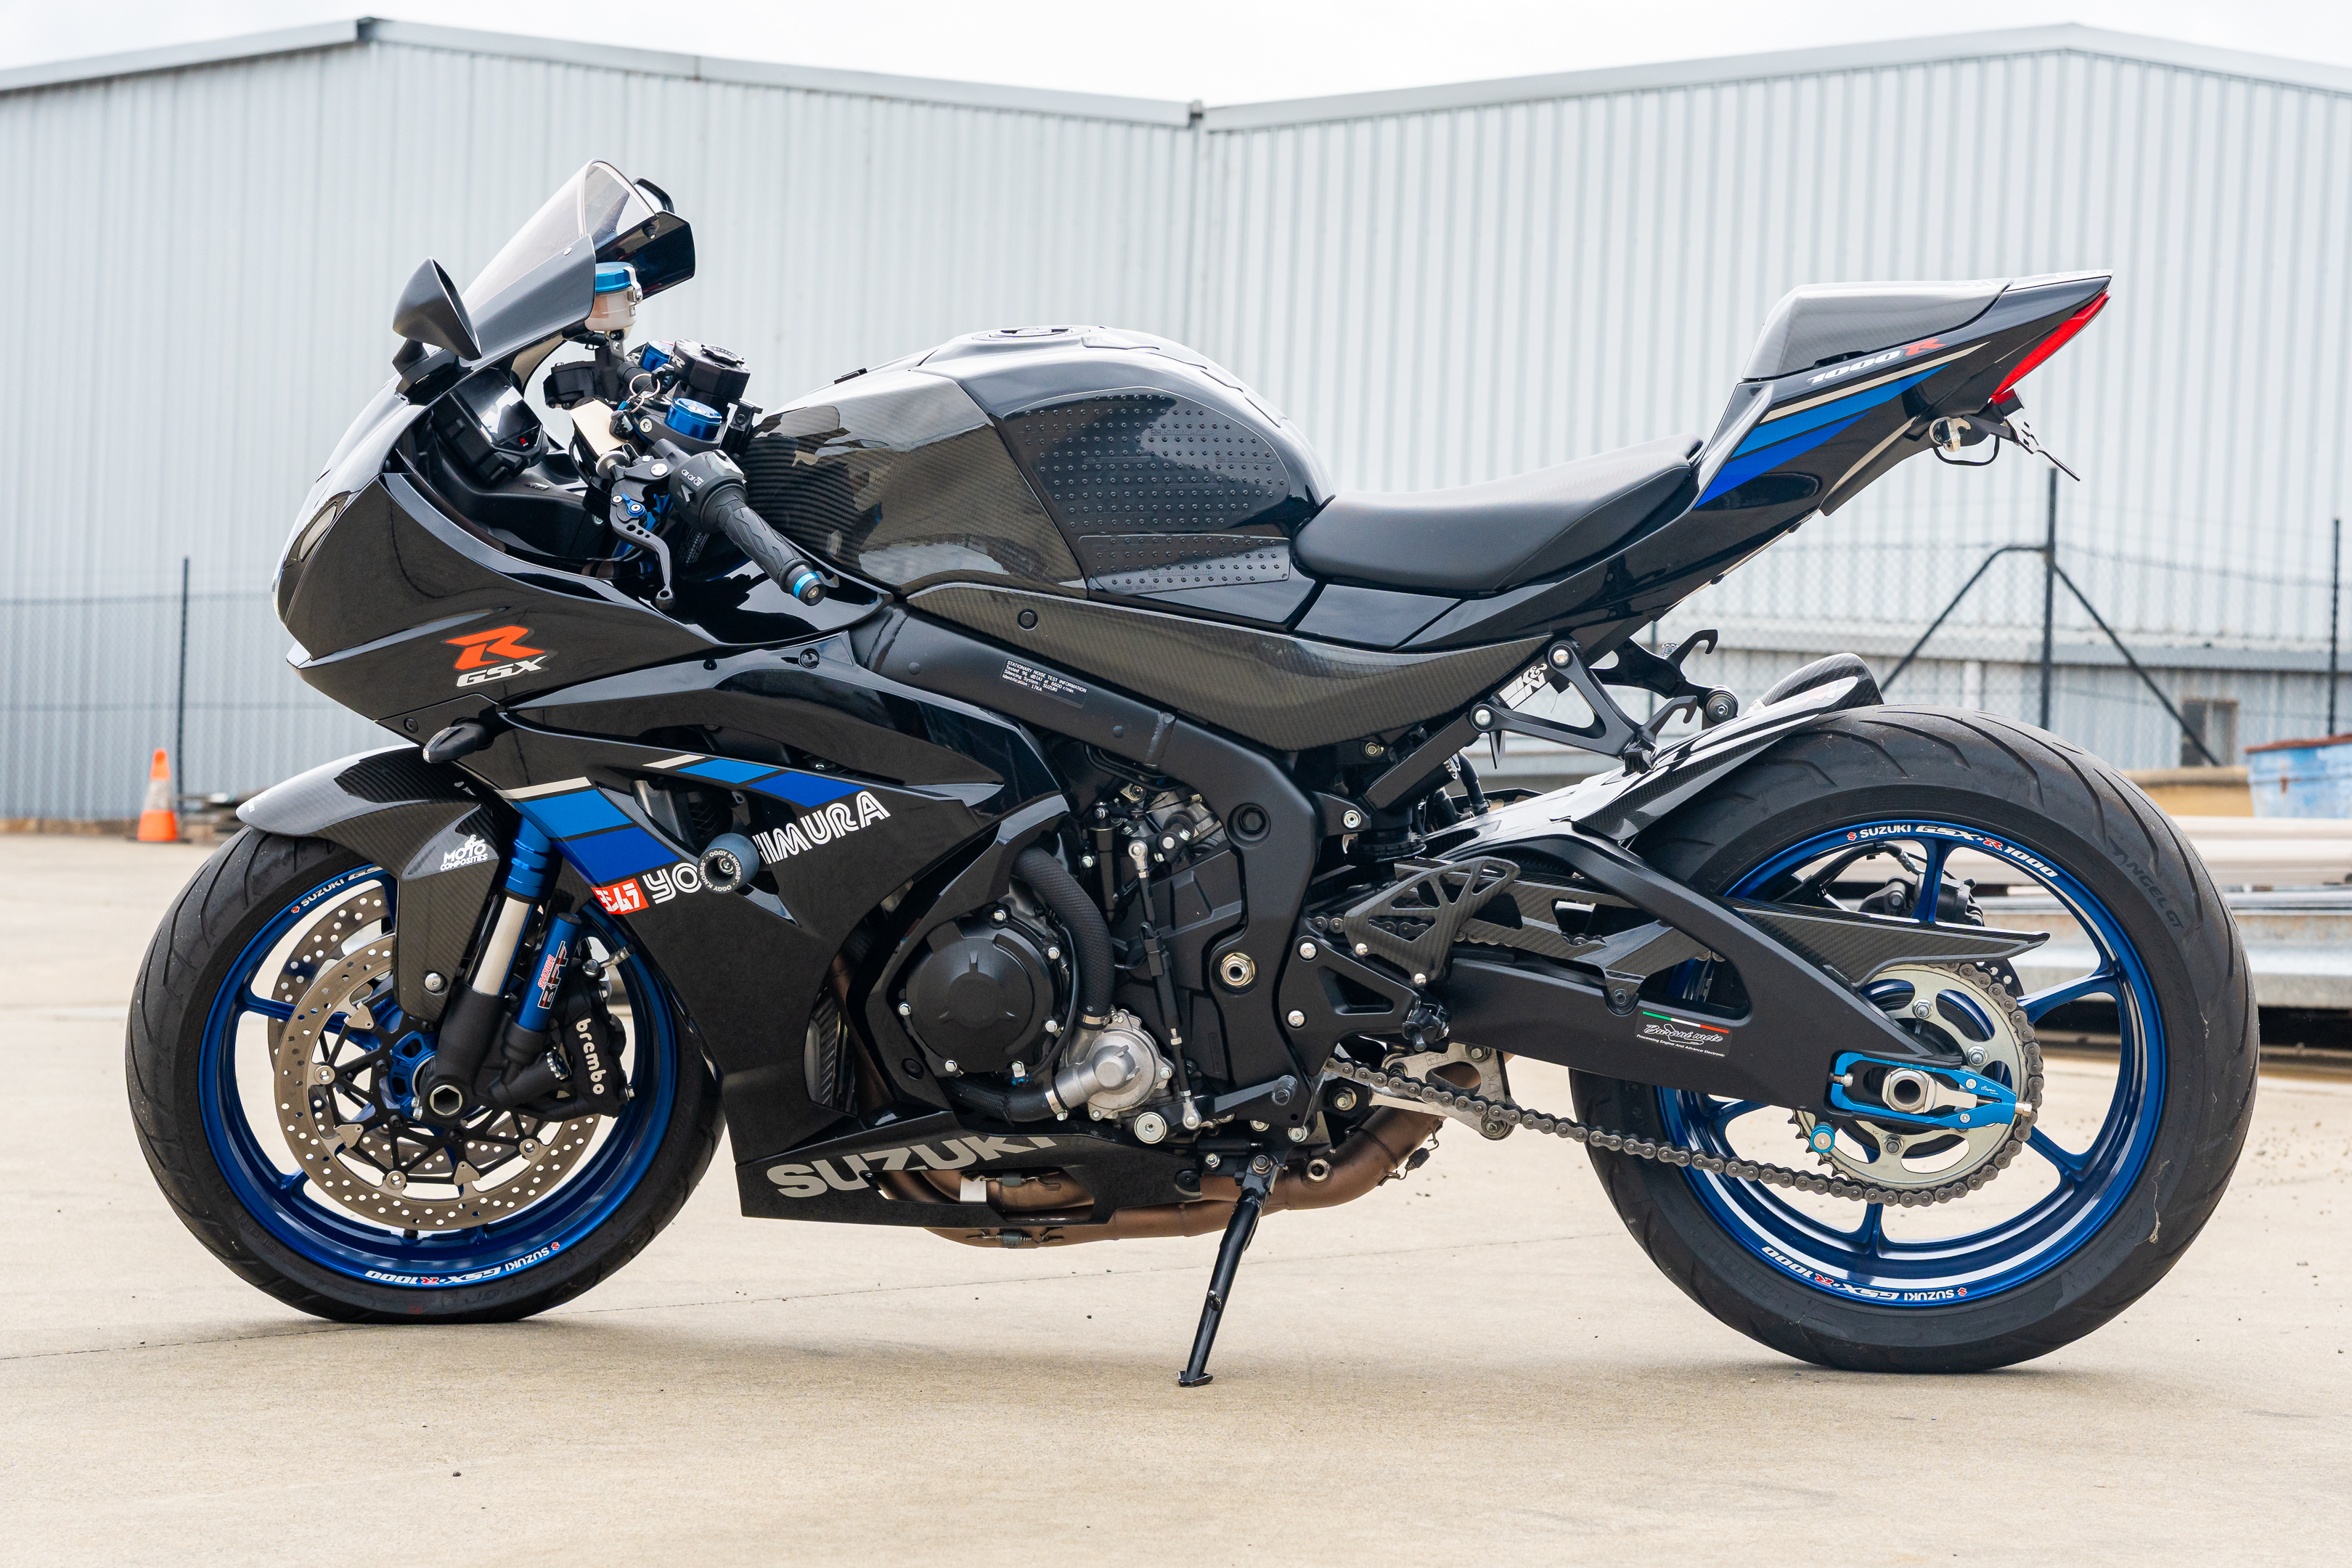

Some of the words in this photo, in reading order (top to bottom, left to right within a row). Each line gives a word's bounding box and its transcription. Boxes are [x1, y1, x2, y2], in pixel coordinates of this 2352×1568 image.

[457, 655, 548, 687] GSX
[1004, 669, 1022, 679] Silencing
[1042, 683, 1058, 693] SUZUKI
[1007, 661, 1032, 673] STATIONARY
[1059, 679, 1087, 693] INFORMATION
[1860, 825, 1911, 838] SUZUKI
[443, 843, 486, 864] MOTO
[642, 791, 891, 905] YOIMURA
[440, 853, 488, 871] COMPOSITES
[301, 878, 345, 907] SUZUKI
[537, 954, 555, 989] SHOWA
[1636, 1034, 1659, 1043] Processing
[1693, 1033, 1723, 1042] moto
[576, 1018, 607, 1095] brembo
[505, 1247, 550, 1271] SUZUKI
[1904, 1289, 1954, 1301] SUZUKI
